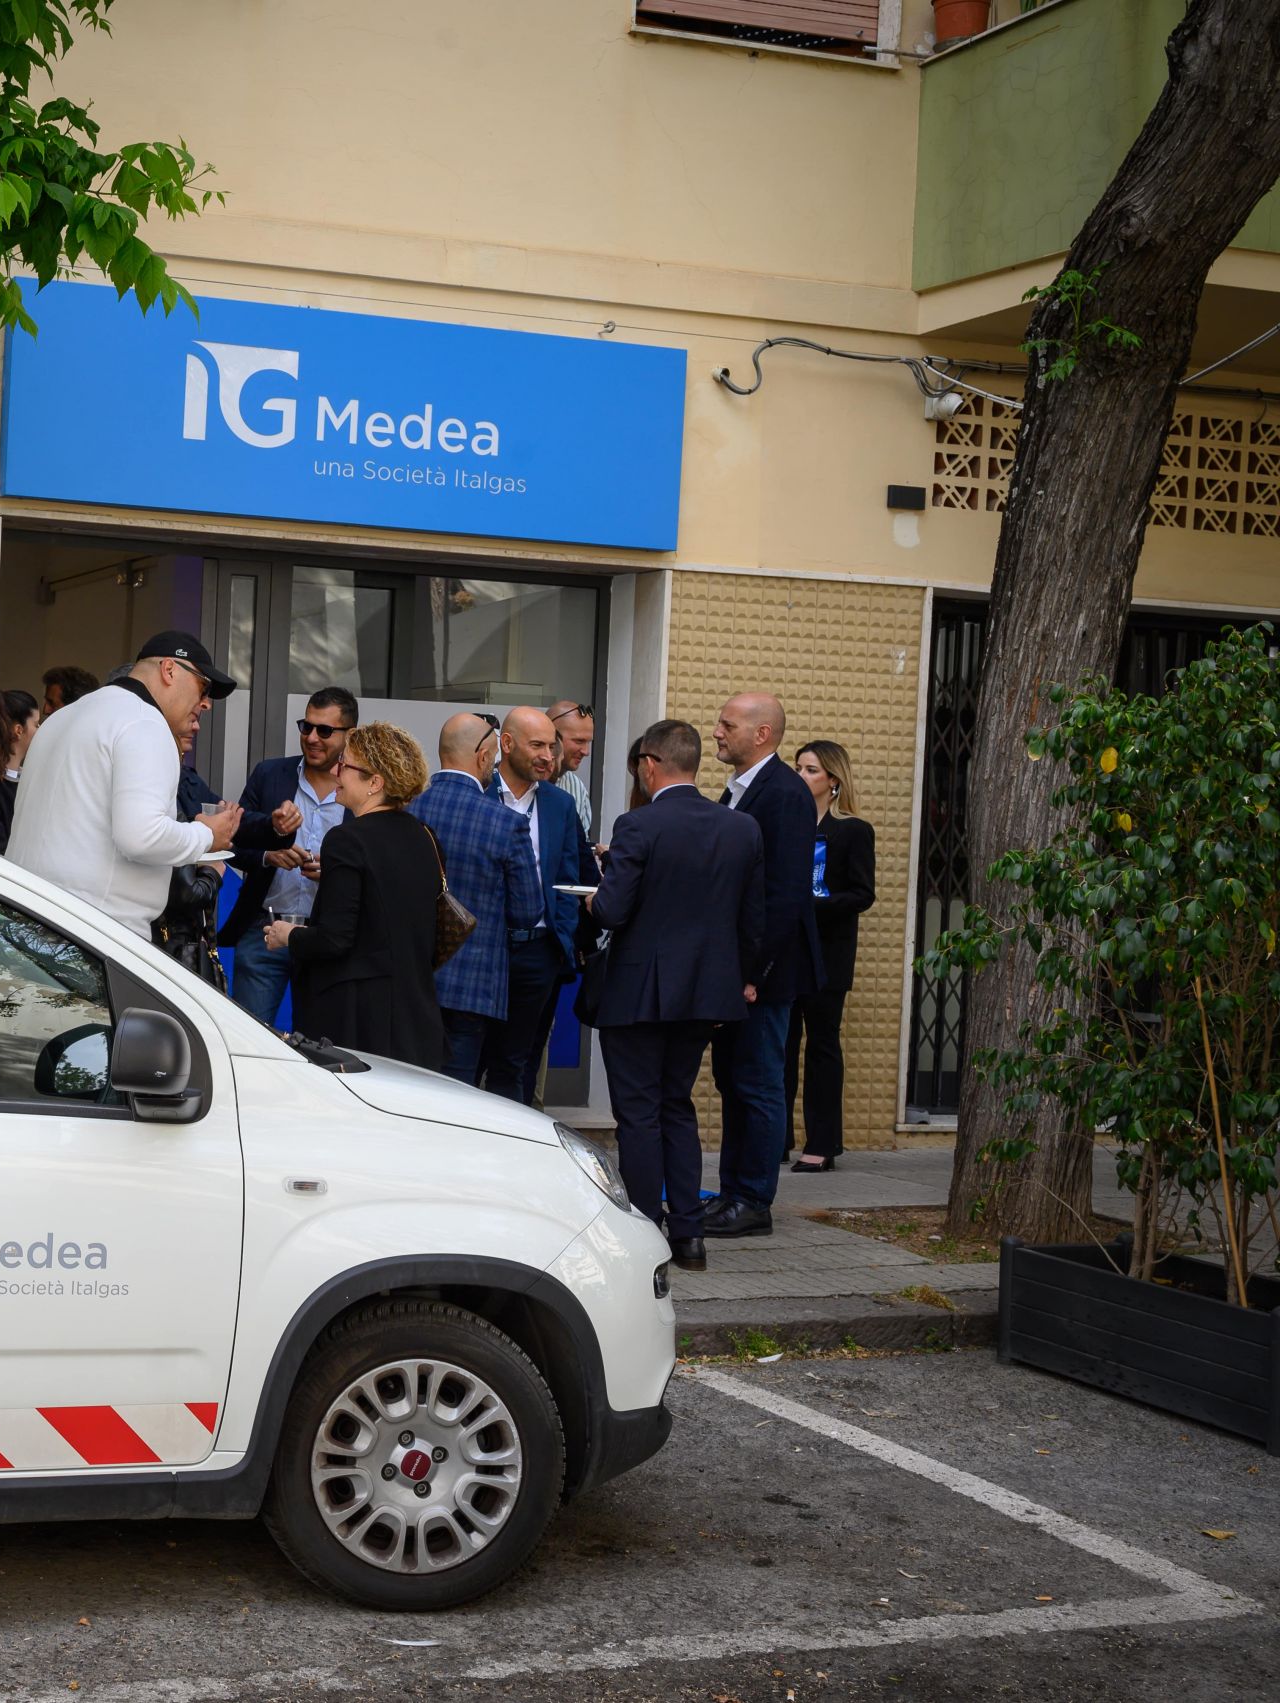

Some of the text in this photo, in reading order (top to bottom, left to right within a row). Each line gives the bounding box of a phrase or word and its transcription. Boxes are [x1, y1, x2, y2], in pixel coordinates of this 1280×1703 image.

[315, 396, 500, 456] Medea
[314, 459, 527, 495] una Società Italgas
[71, 1281, 129, 1298] Italgas
